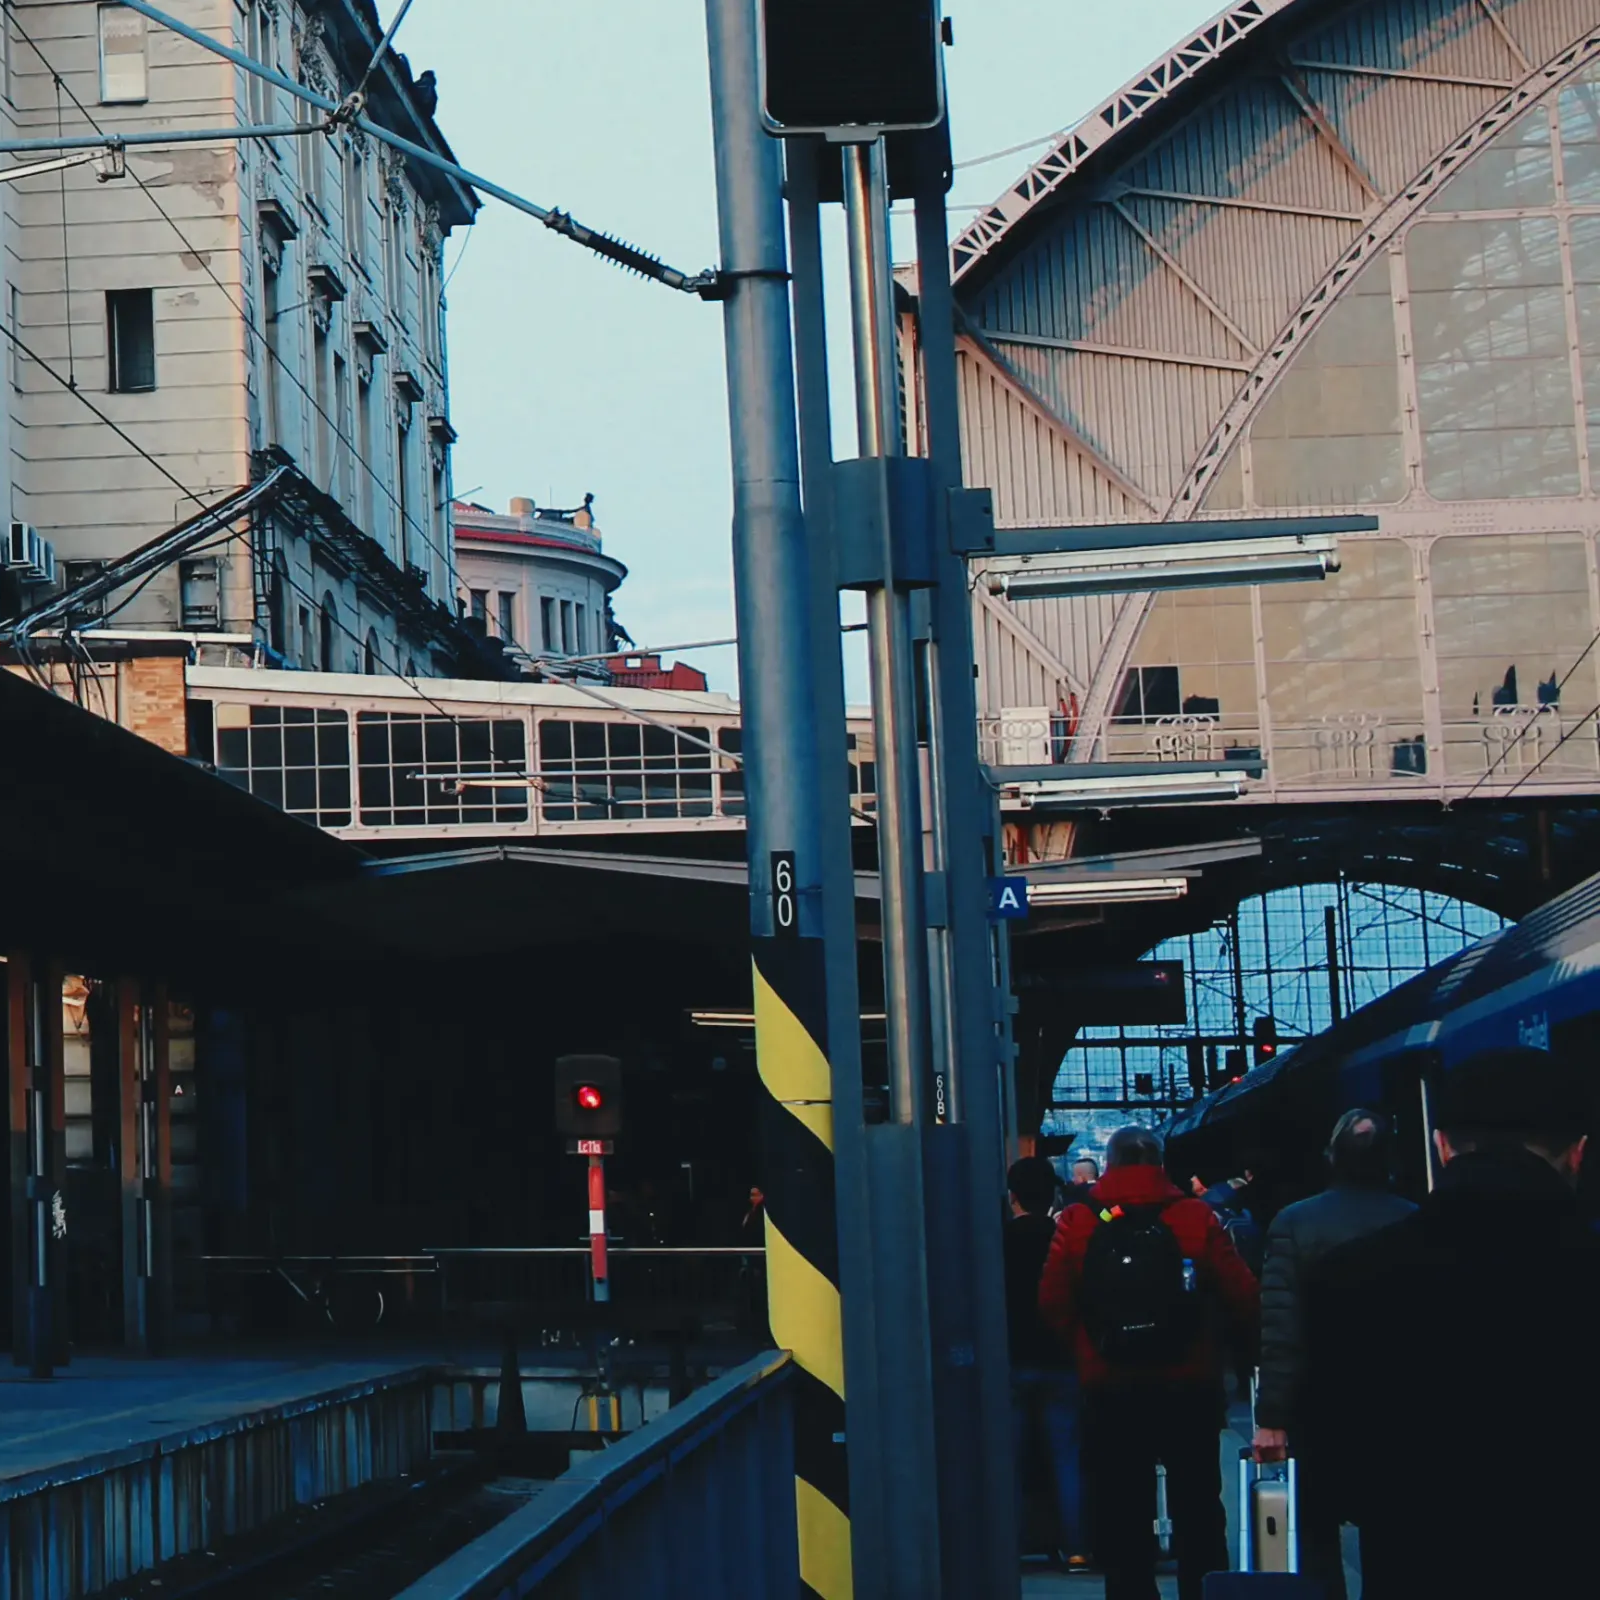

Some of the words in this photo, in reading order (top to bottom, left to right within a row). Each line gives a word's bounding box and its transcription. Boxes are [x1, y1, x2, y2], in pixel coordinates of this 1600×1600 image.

[776, 859, 793, 927] 60
[998, 886, 1020, 909] A
[174, 1084, 184, 1095] A
